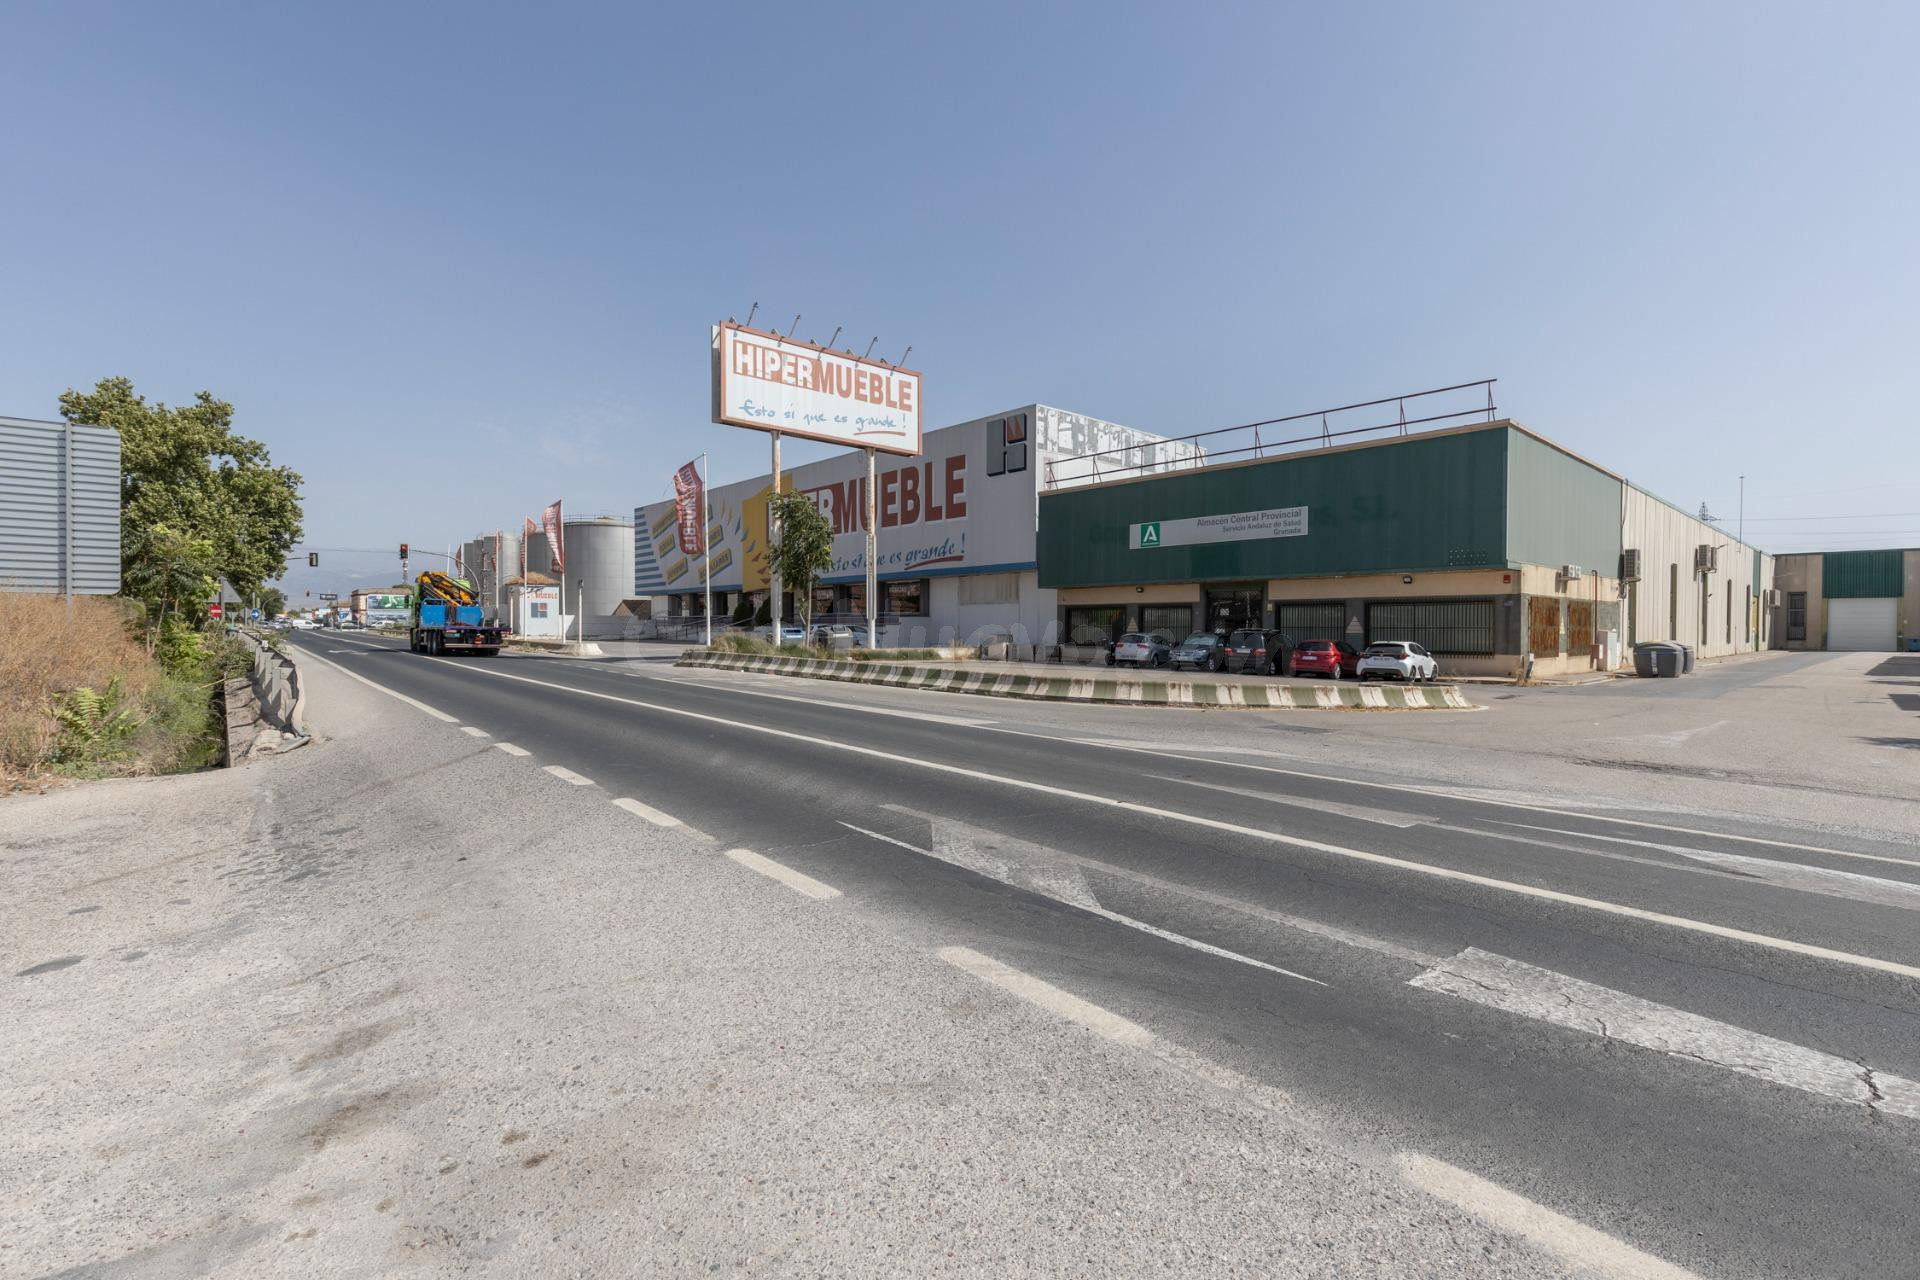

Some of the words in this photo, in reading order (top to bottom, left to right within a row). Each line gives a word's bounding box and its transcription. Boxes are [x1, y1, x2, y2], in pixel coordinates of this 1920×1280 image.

[735, 341, 912, 412] HIPERMUEBLE
[739, 399, 775, 417] Esto
[803, 412, 827, 425] que
[834, 414, 848, 423] es
[1230, 513, 1259, 524] Central
[1261, 509, 1301, 521] Provincial
[1273, 520, 1282, 528] de
[1283, 518, 1301, 527] Salud
[1273, 527, 1301, 536] Granada
[905, 538, 956, 565] grande
